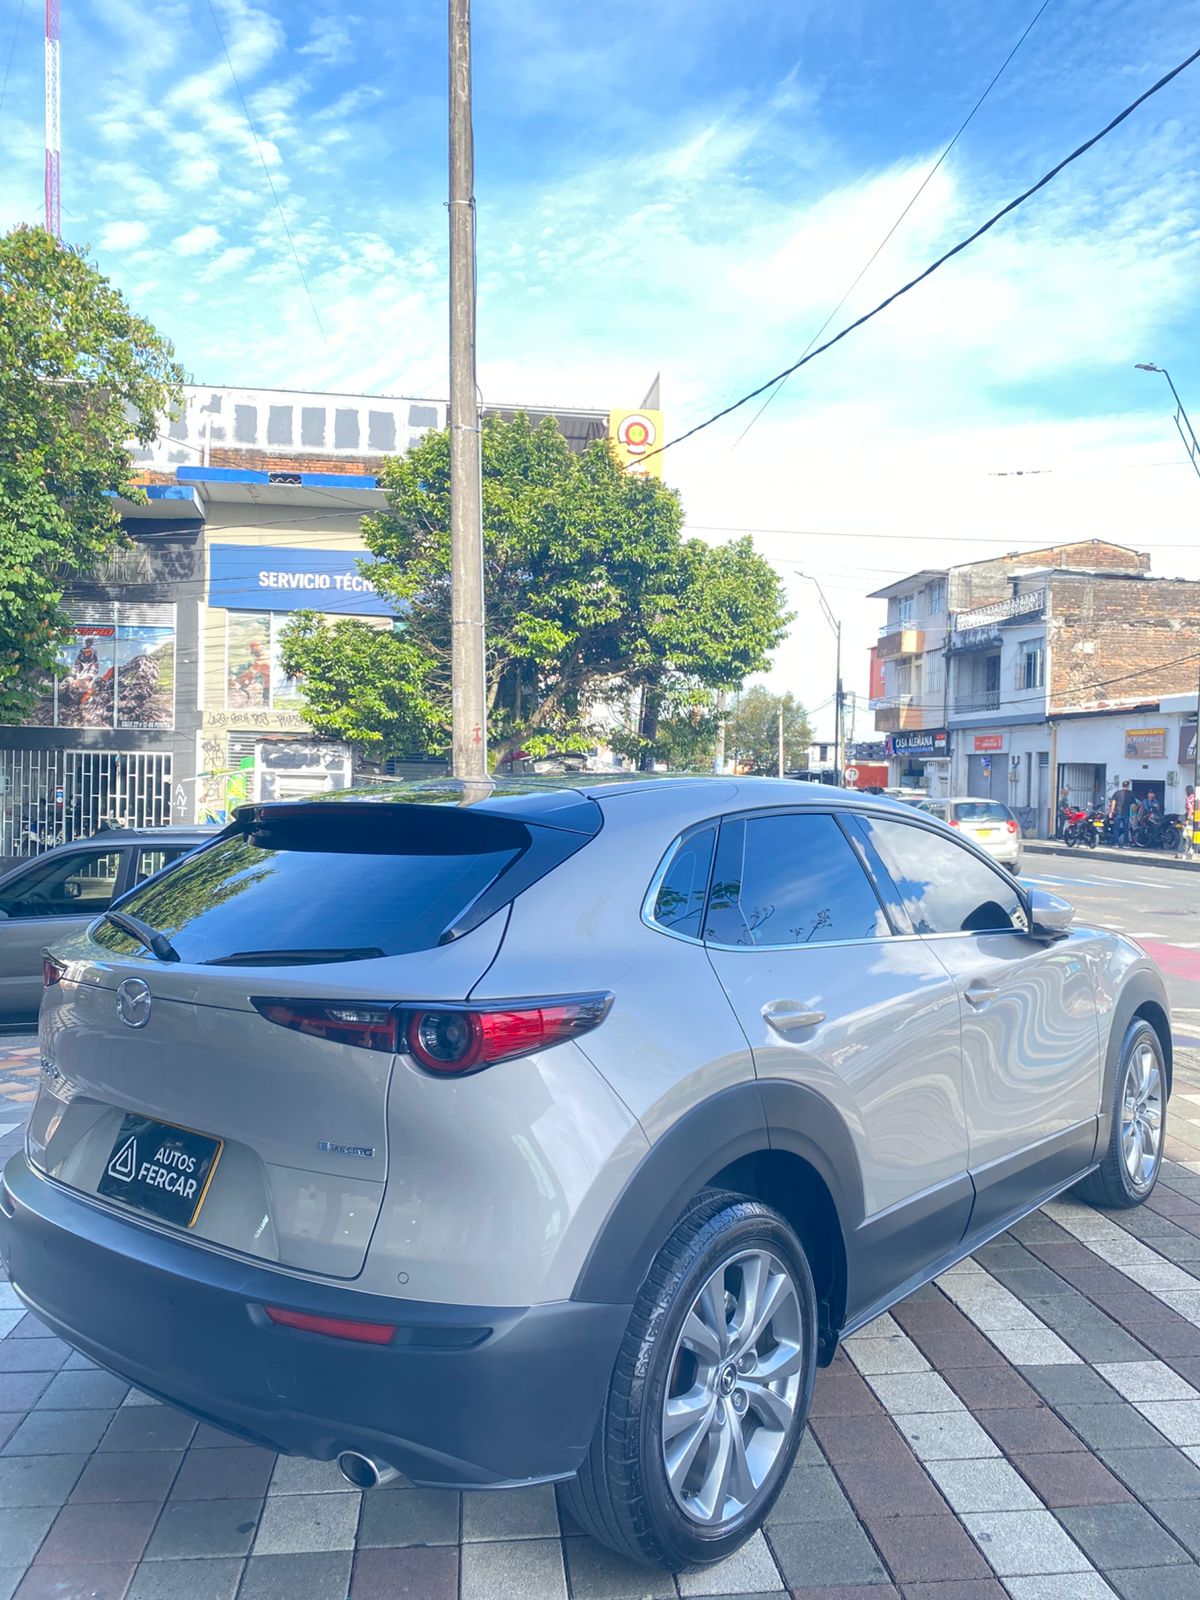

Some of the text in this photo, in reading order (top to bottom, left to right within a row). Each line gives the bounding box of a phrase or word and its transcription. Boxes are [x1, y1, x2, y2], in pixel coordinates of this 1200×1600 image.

[137, 548, 152, 581] 4
[258, 571, 376, 592] SERVICIO TÉCN
[895, 737, 908, 748] CASA
[908, 734, 933, 747] ALEMANA
[154, 1147, 197, 1173] AUTOS
[138, 1162, 198, 1199] FERCAR
